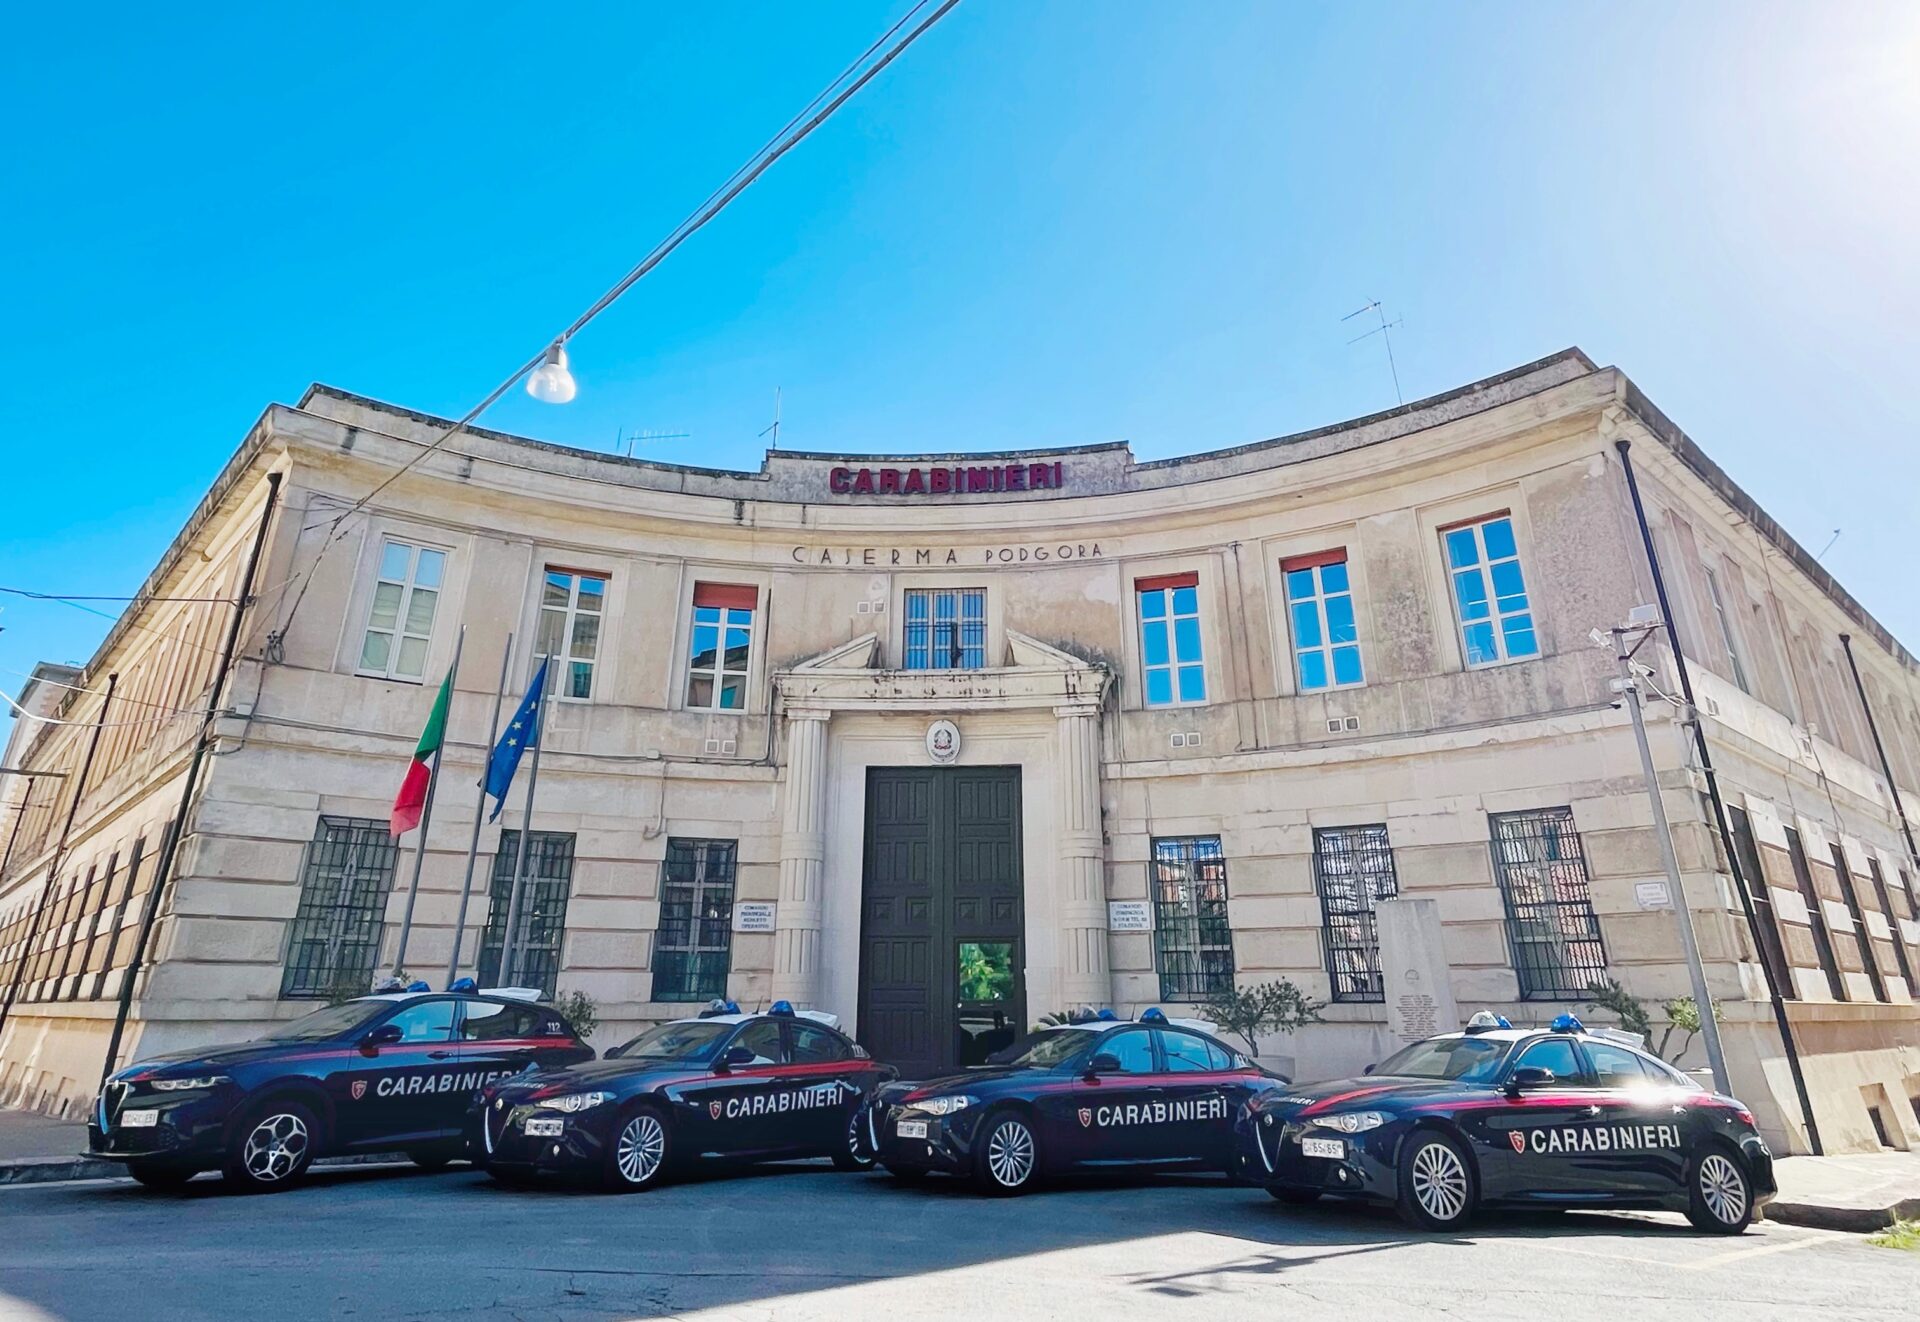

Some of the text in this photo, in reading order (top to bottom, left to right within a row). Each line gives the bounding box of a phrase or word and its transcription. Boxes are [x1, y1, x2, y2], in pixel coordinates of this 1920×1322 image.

[830, 462, 1062, 493] CARABINIERI
[792, 543, 1102, 565] CASERMA PODGORA
[726, 1086, 844, 1119] CARABINIERI
[1097, 1098, 1228, 1127] CARABINIERI
[1531, 1125, 1681, 1154] CARABINIERI
